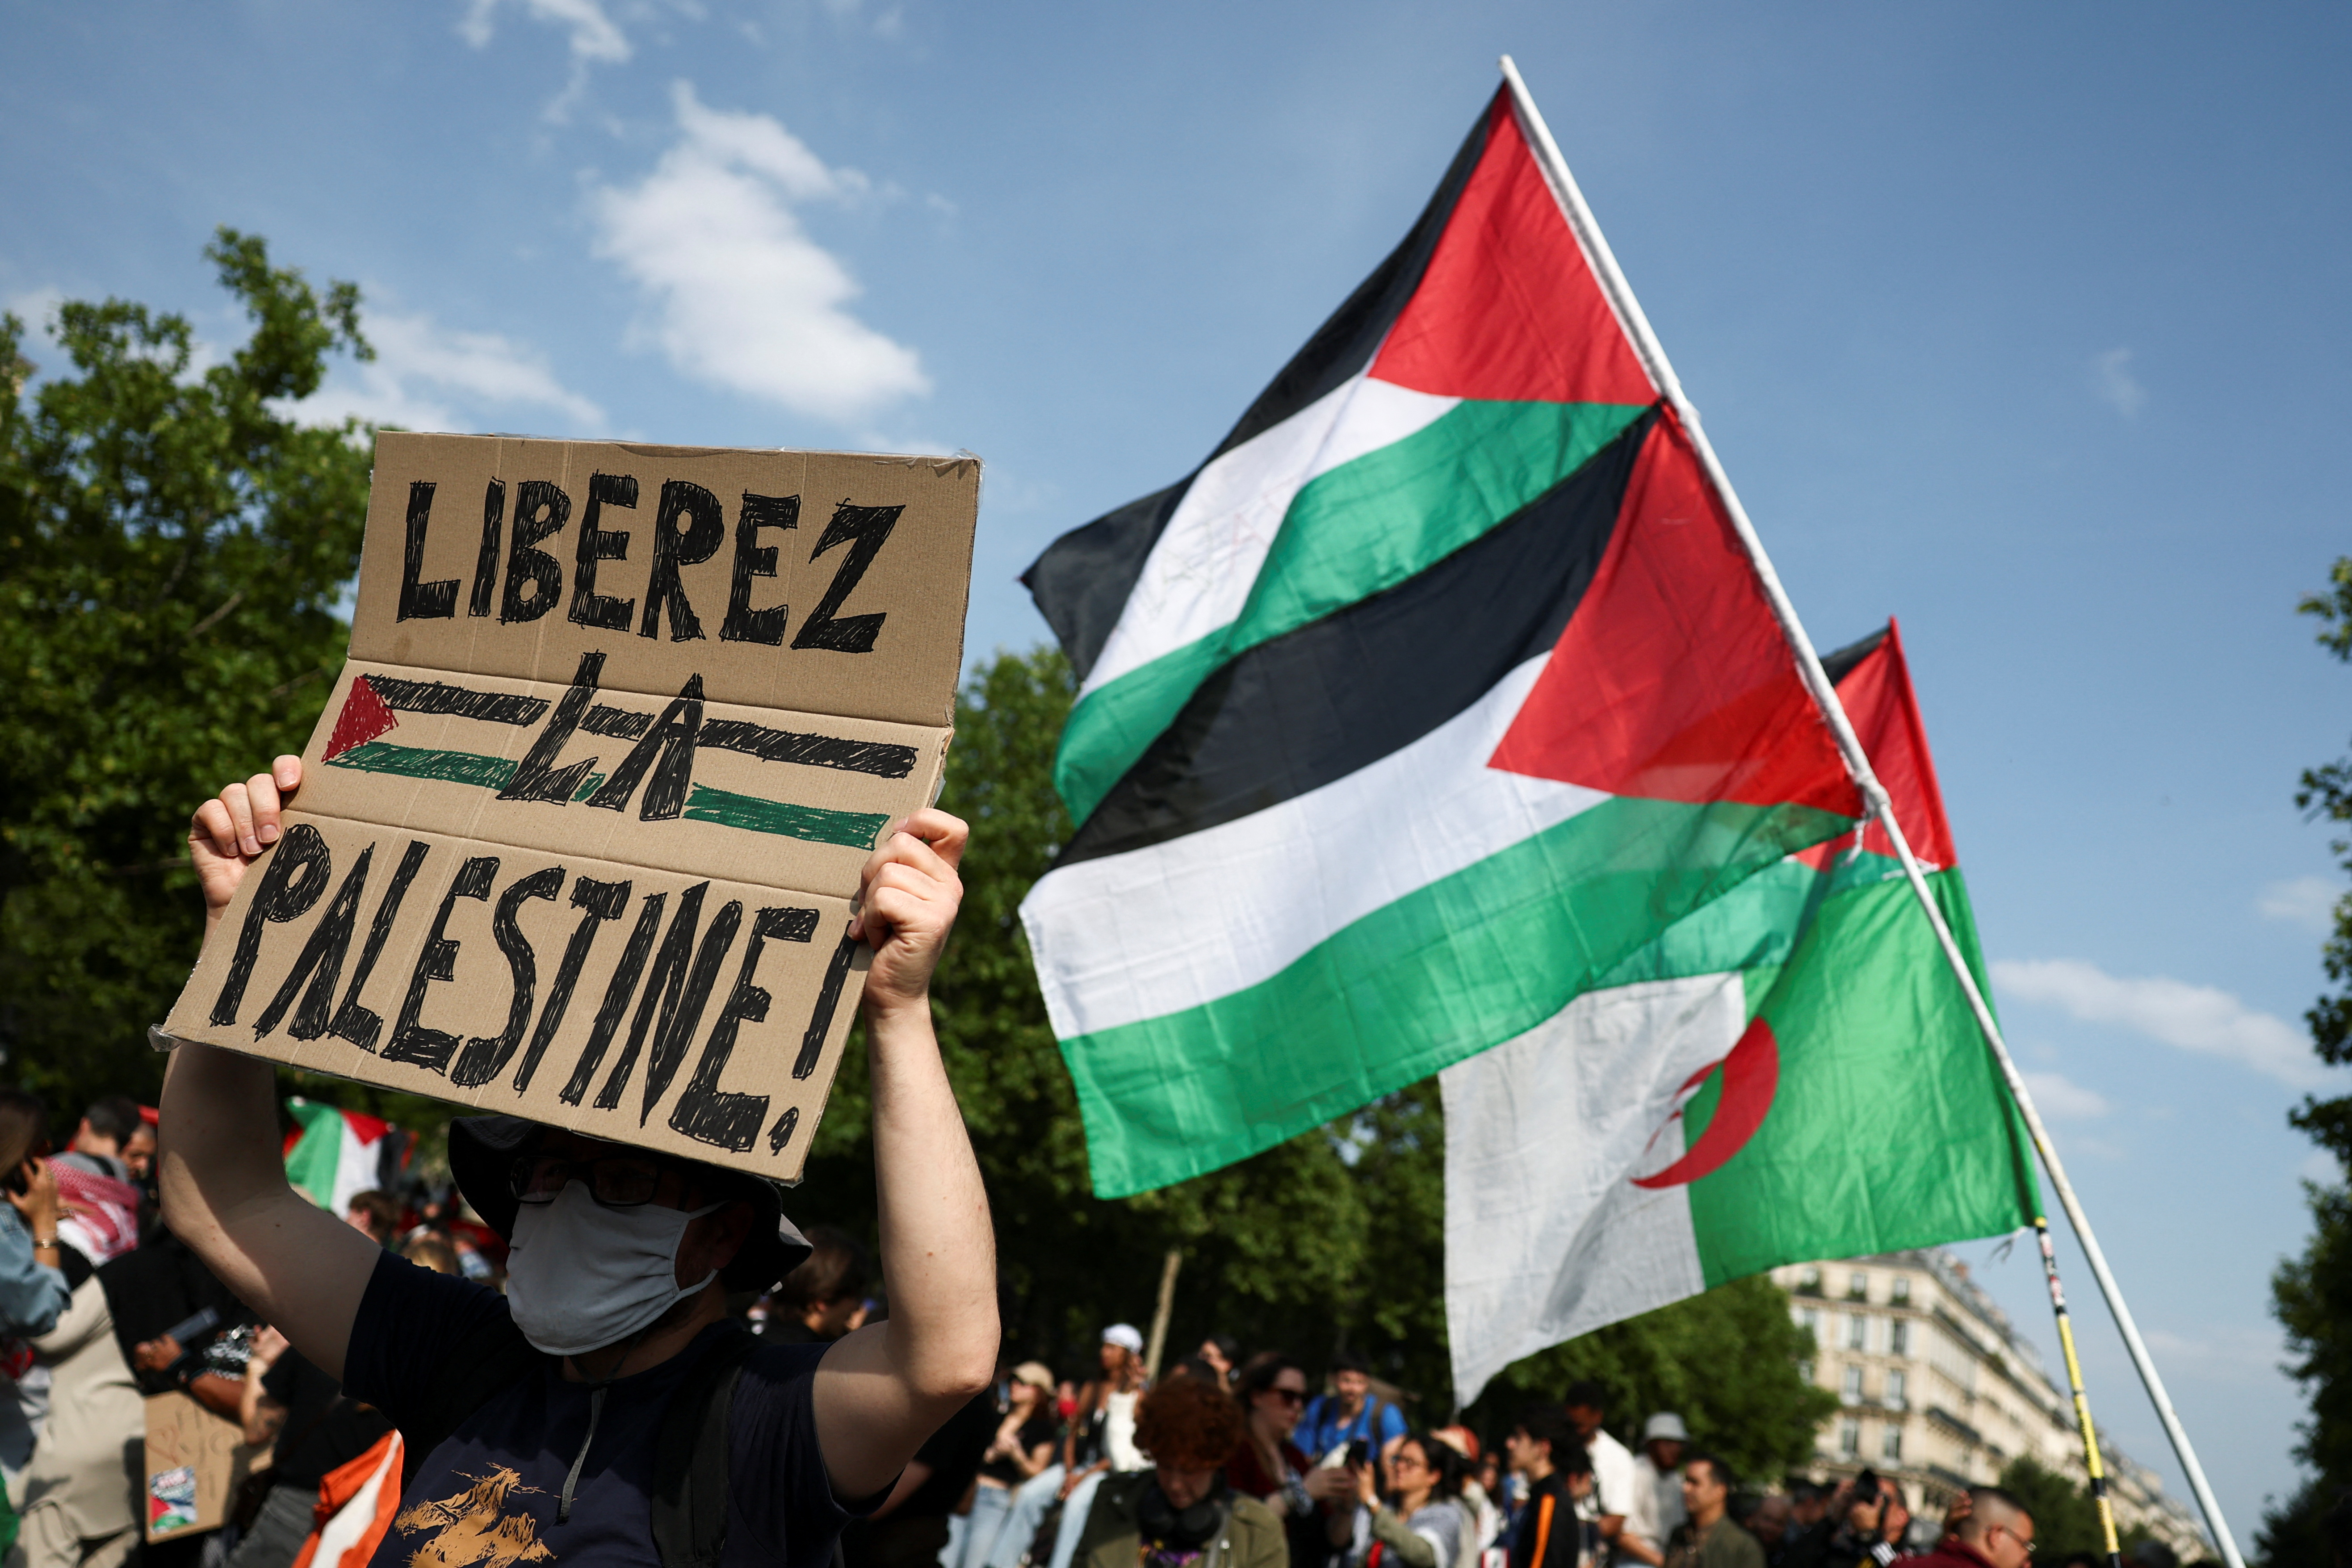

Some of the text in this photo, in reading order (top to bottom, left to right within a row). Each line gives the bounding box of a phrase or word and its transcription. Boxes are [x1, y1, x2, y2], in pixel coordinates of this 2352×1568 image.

[397, 471, 906, 653] LIBEREZ
[496, 650, 705, 822] LA
[209, 824, 859, 1156] PALESTINE!
